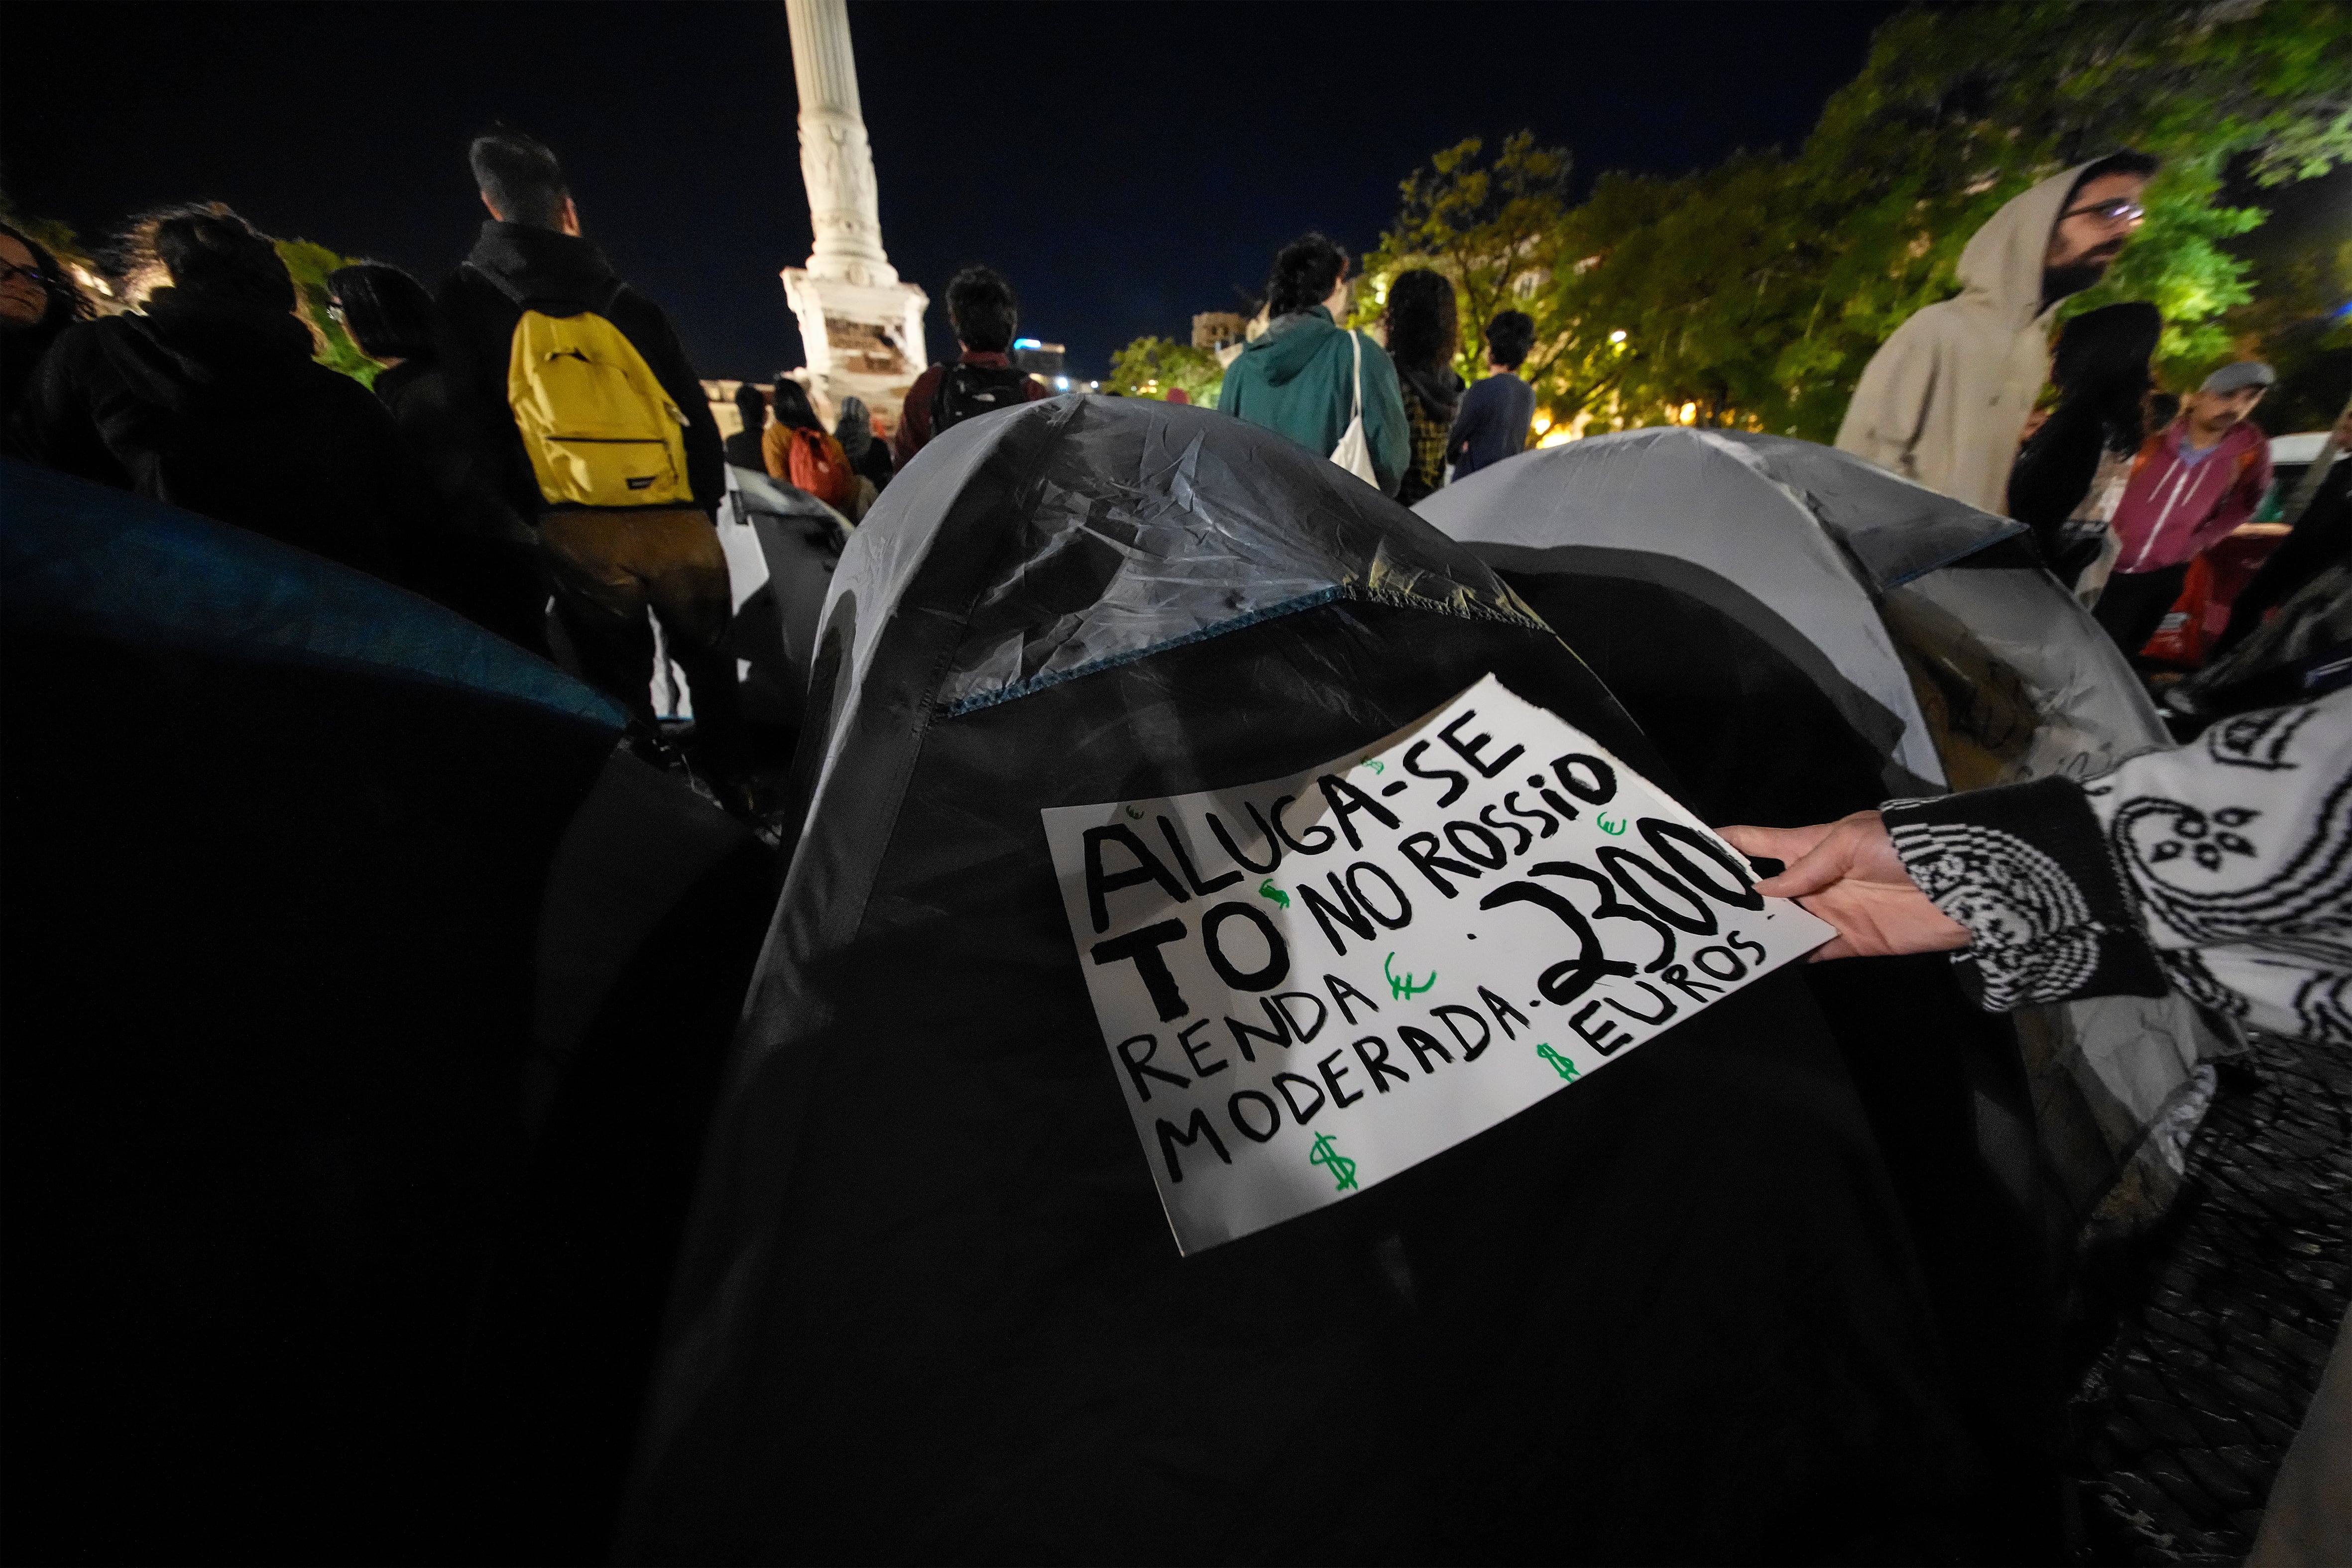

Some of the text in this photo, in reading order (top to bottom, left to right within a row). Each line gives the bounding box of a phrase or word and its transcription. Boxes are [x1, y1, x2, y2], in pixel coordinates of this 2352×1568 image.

[1083, 709, 1526, 933] ALUGA-SE
[1090, 902, 1290, 1022] TO
[1296, 862, 1412, 955] NO
[1480, 817, 1764, 1006] 2300
[1117, 974, 1380, 1102] RENDA
[1568, 931, 1766, 1056] EUROS
[1310, 1131, 1358, 1190] $
